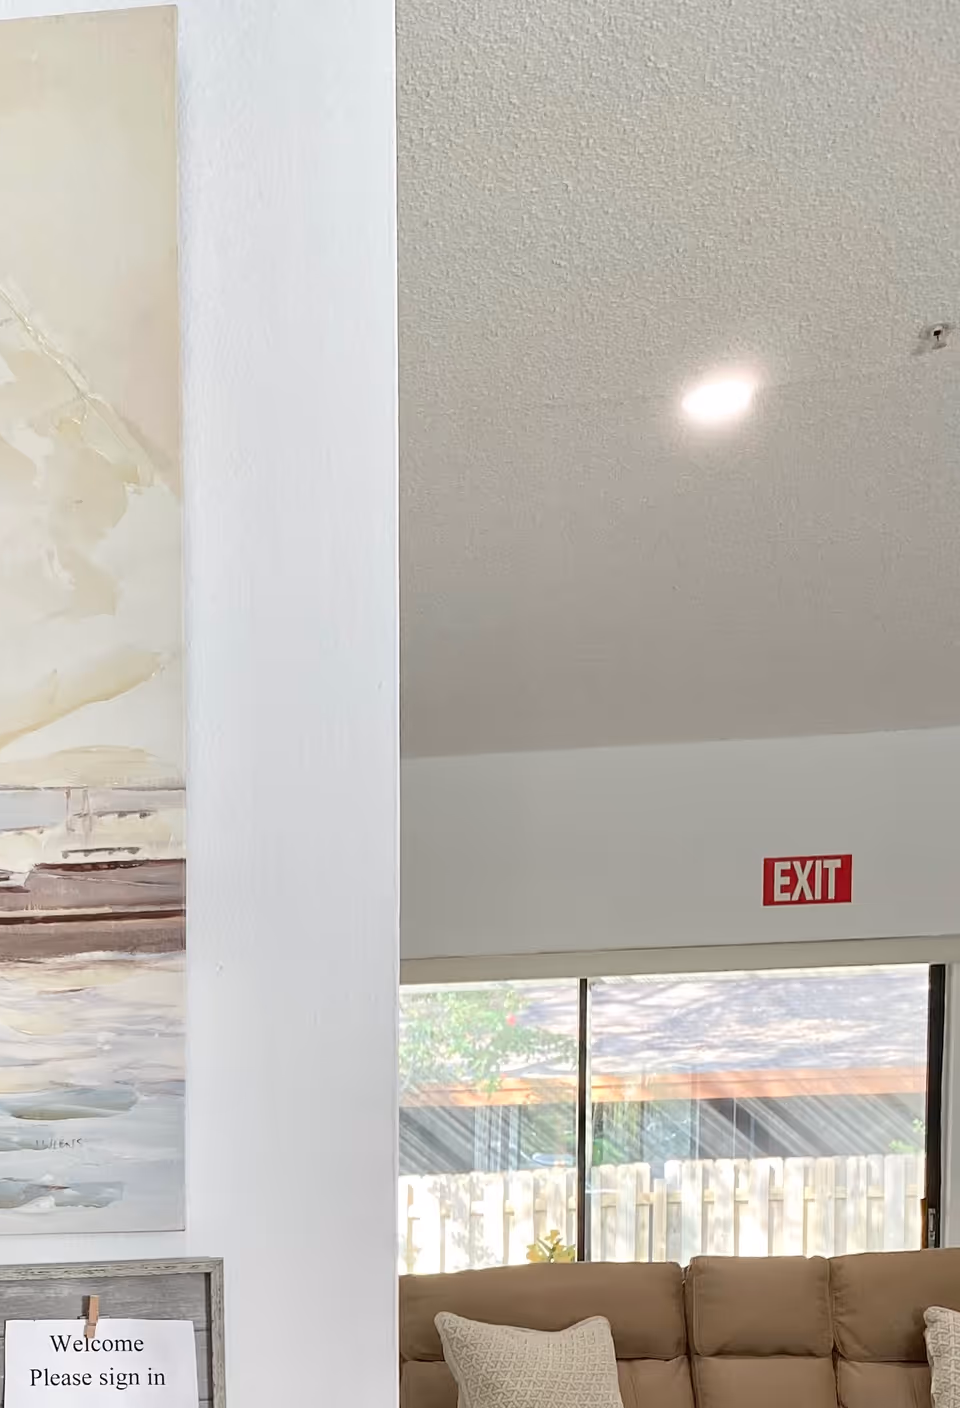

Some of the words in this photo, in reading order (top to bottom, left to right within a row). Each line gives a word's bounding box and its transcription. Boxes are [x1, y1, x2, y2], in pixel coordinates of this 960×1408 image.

[773, 859, 841, 902] EXIT
[50, 1334, 144, 1352] Welcome
[30, 1367, 92, 1387] Please
[99, 1367, 140, 1390] sign
[147, 1368, 166, 1386] in
